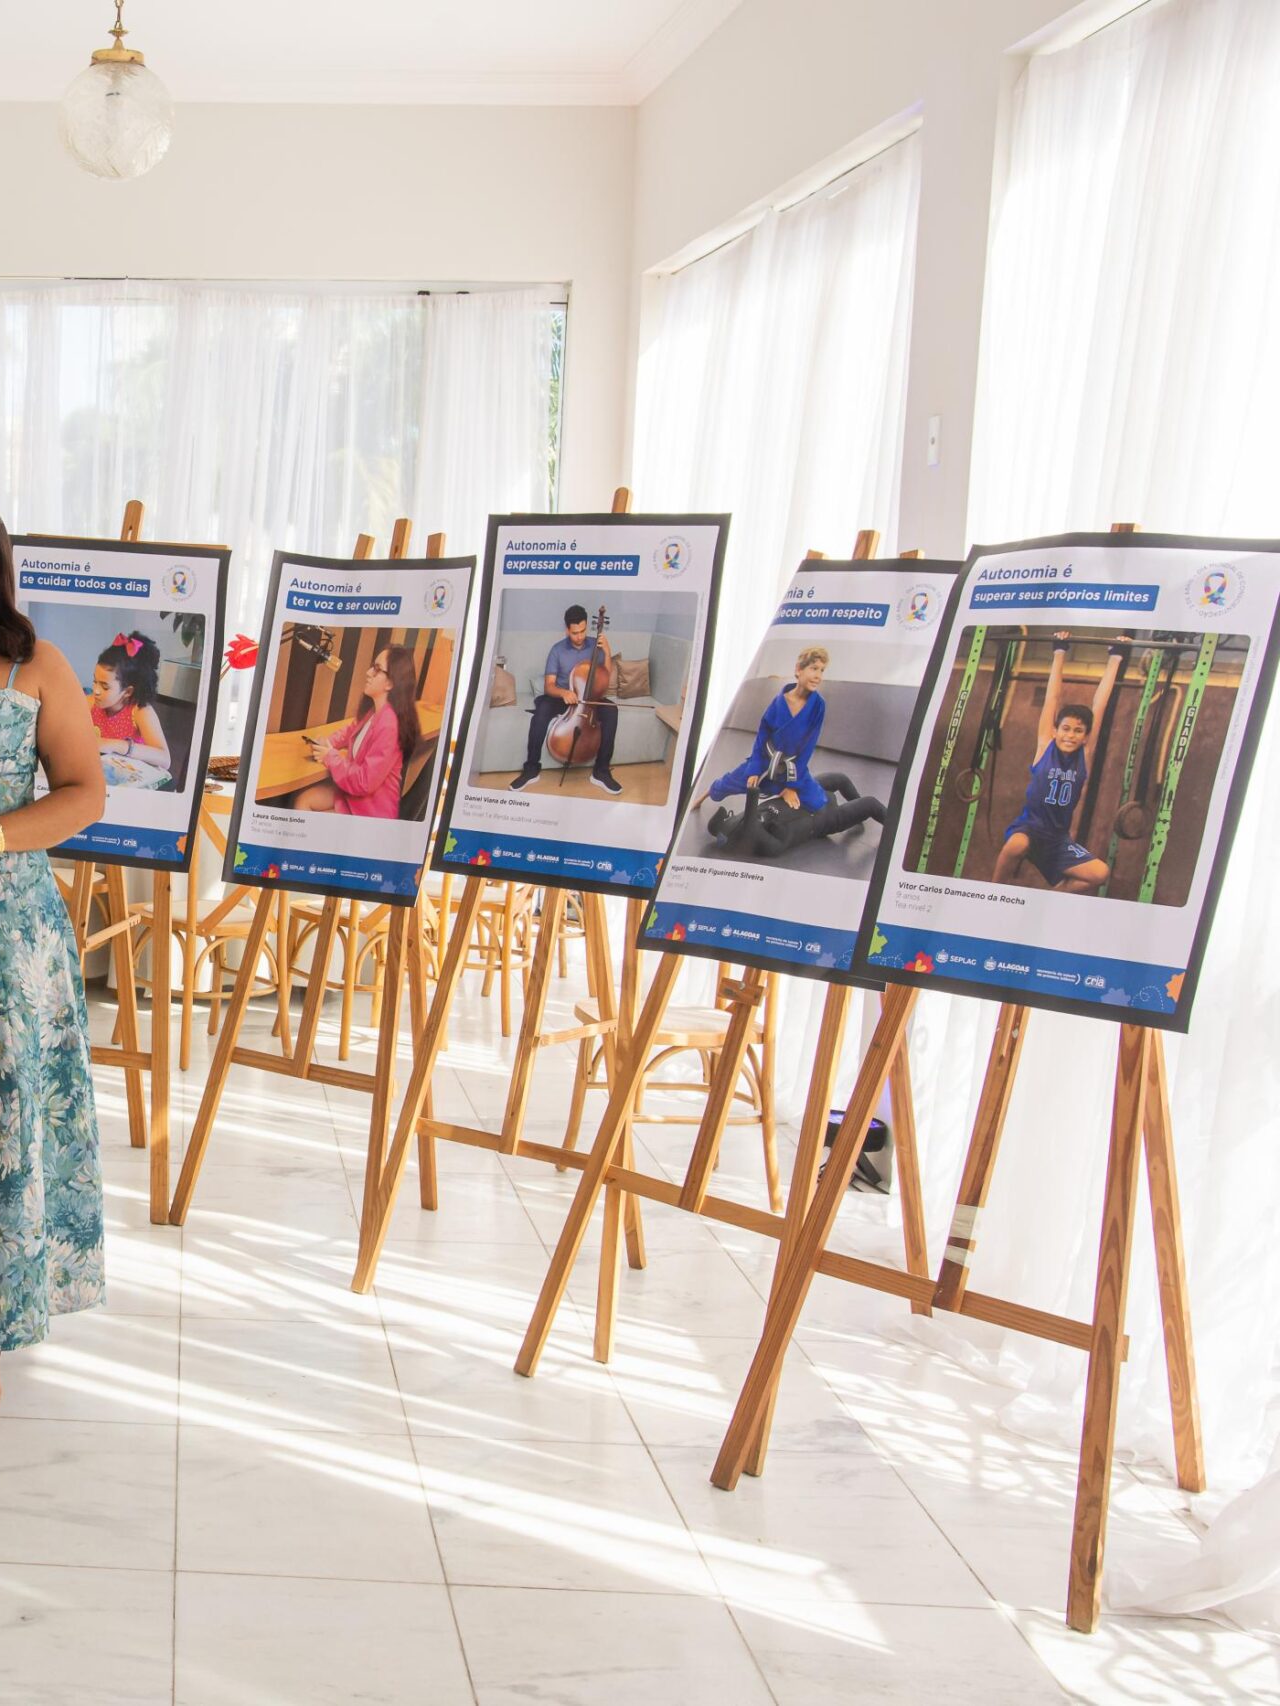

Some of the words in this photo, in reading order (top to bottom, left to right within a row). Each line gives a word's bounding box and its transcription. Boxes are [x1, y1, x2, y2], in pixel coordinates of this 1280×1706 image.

[506, 540, 566, 551] Autonomia
[570, 539, 577, 551] é
[22, 558, 81, 572] Autonomia
[85, 562, 91, 572] é
[506, 560, 560, 571] expressar
[563, 561, 571, 569] o
[574, 561, 597, 573] que
[600, 560, 633, 571] sente
[978, 565, 1058, 581] Autonomia
[1063, 564, 1073, 578] é
[37, 576, 71, 587] cuidar
[75, 578, 106, 589] todos
[110, 582, 122, 590] os
[125, 581, 148, 592] dias
[290, 578, 353, 593] Autonomia
[356, 583, 362, 592] é
[807, 587, 814, 598] é
[974, 590, 1016, 602] superar
[1018, 590, 1043, 600] seus
[1046, 587, 1100, 602] próprios
[1104, 590, 1149, 602] limites
[292, 596, 309, 607] ter
[314, 600, 334, 610] voz
[337, 602, 343, 610] e
[345, 602, 360, 610] ser
[363, 600, 397, 611] ouvido
[805, 608, 829, 617] com
[832, 608, 882, 620] respeito
[1045, 779, 1072, 806] 10
[708, 868, 739, 877] Figueiredo
[740, 872, 764, 881] Silveira
[898, 882, 917, 890] Vitor
[919, 884, 942, 894] Carlos
[944, 888, 985, 900] Damaceno
[987, 893, 998, 901] da
[1000, 895, 1025, 905] Rocha
[733, 929, 760, 939] ALAGOAS
[950, 955, 976, 966] SEPLAG
[998, 962, 1030, 973] ALAGOAS
[1084, 975, 1105, 987] cria
